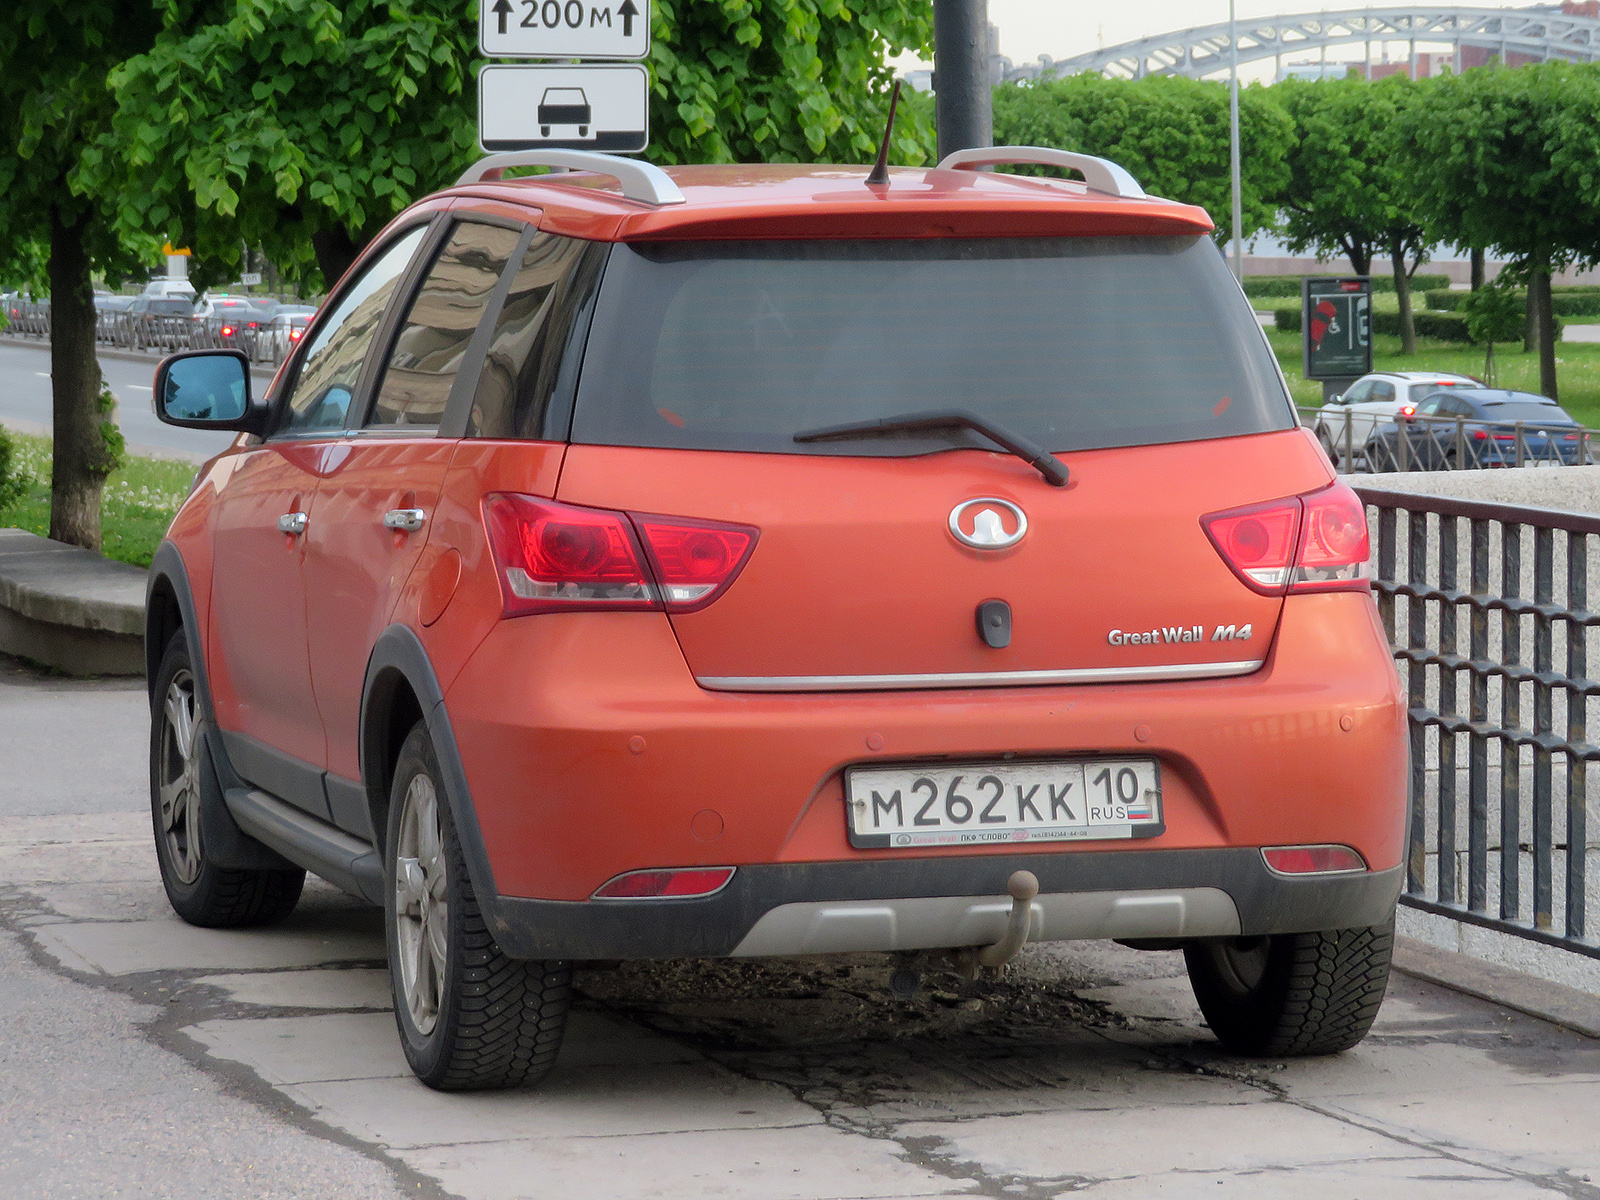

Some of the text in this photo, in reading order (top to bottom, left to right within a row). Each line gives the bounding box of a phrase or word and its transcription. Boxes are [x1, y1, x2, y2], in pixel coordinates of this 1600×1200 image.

[1107, 623, 1253, 646] Great Wall M4
[1092, 766, 1139, 806] 10
[871, 775, 1077, 828] М262КК
[1090, 806, 1126, 821] RUS
[912, 834, 958, 844] Great Wall
[960, 834, 977, 842] ПКФ
